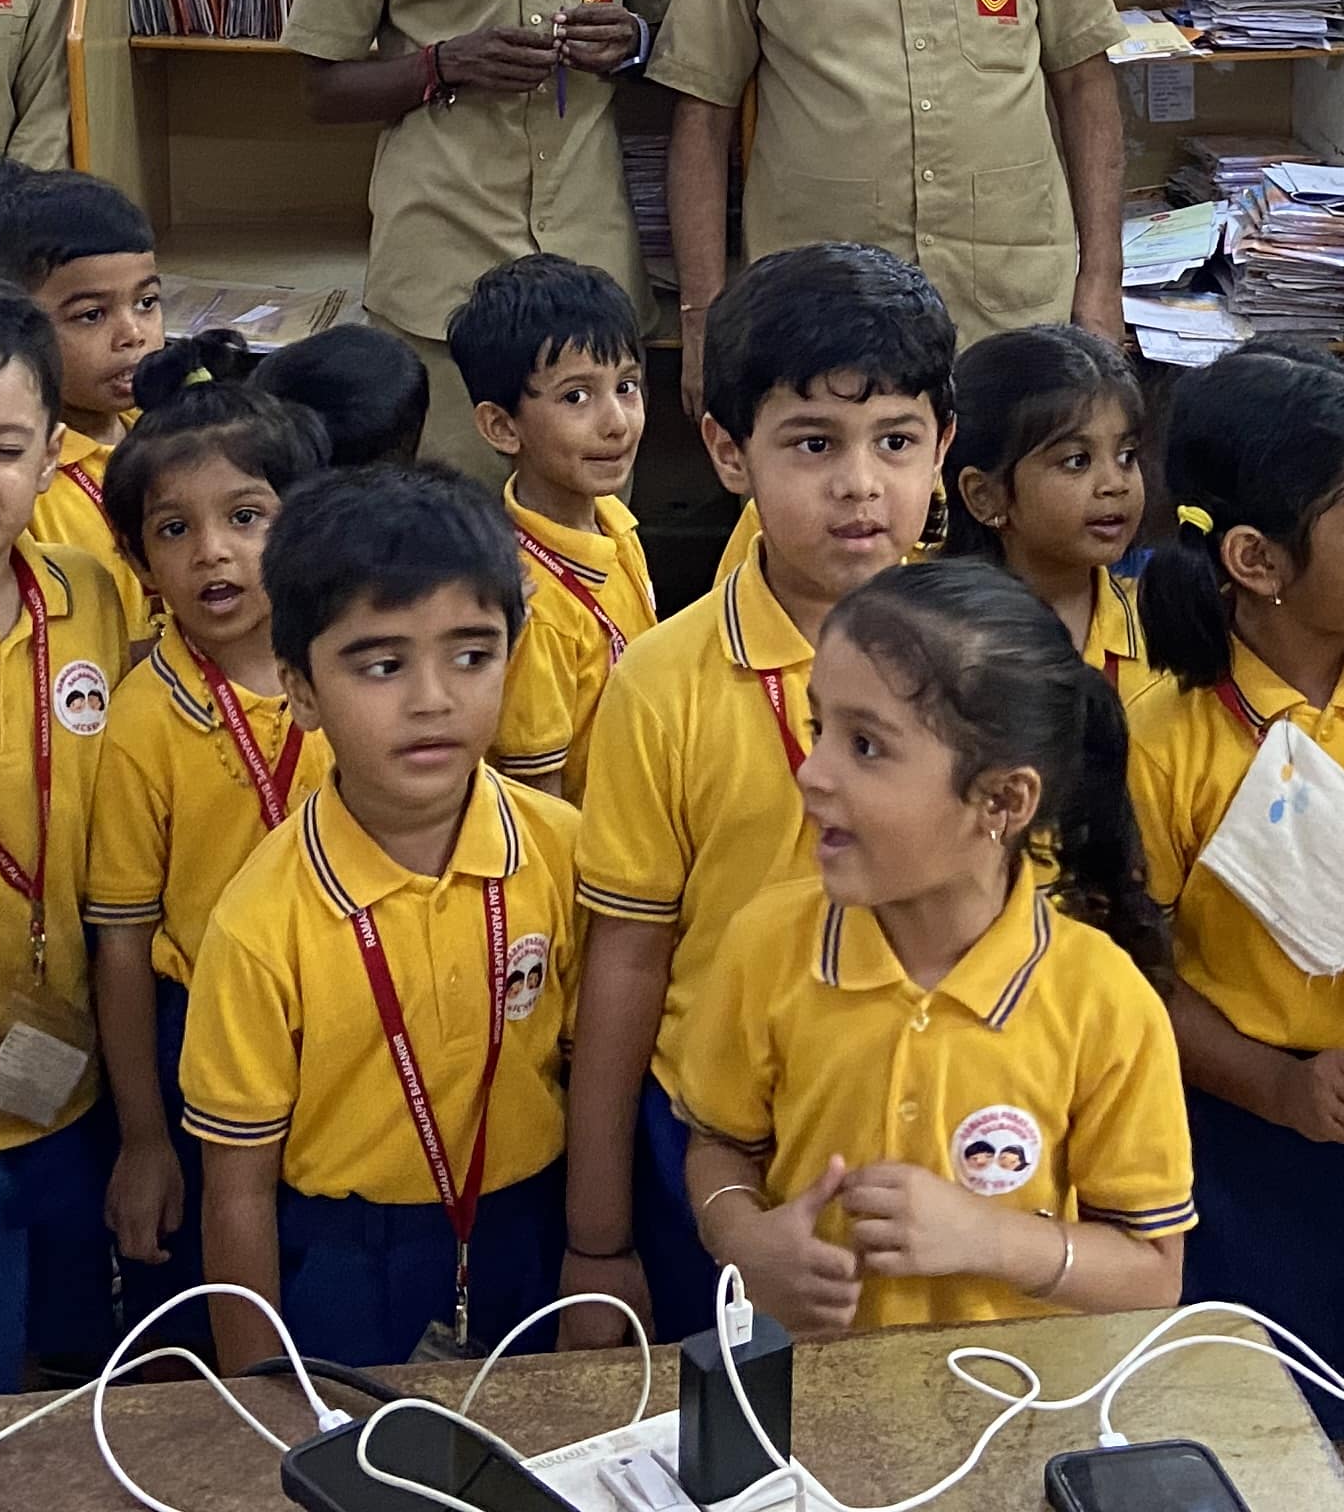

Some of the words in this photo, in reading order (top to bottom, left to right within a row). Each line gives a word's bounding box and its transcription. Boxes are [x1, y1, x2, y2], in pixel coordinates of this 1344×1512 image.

[71, 466, 104, 504] PARANJA
[524, 539, 564, 576] BALMANDIR
[216, 684, 240, 728] RAMABAI
[235, 727, 267, 784] PARANJAPE
[260, 783, 280, 826] BALMAN
[488, 879, 499, 905] ABAI
[355, 908, 376, 947] RAMA
[490, 907, 504, 974] PARANJAPE
[392, 1032, 421, 1096] BALMANDIR
[413, 1096, 441, 1159] PARANJAPE
